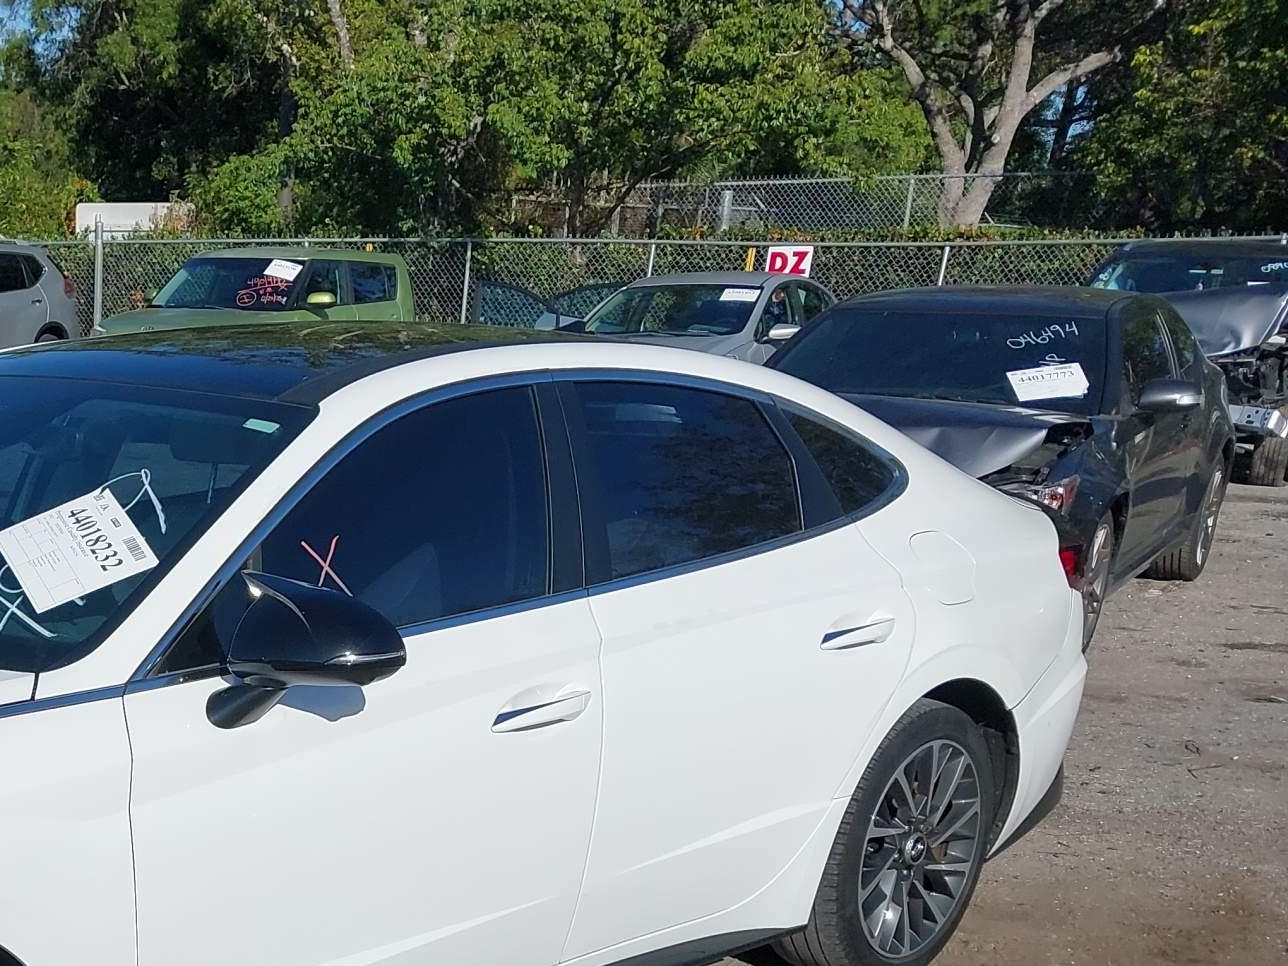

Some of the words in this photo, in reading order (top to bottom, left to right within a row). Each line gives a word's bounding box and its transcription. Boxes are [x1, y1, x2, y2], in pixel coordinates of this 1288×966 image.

[768, 250, 810, 275] DZ
[1006, 320, 1079, 349] 046494
[1018, 370, 1075, 383] 44017773
[67, 507, 124, 572] 44018232
